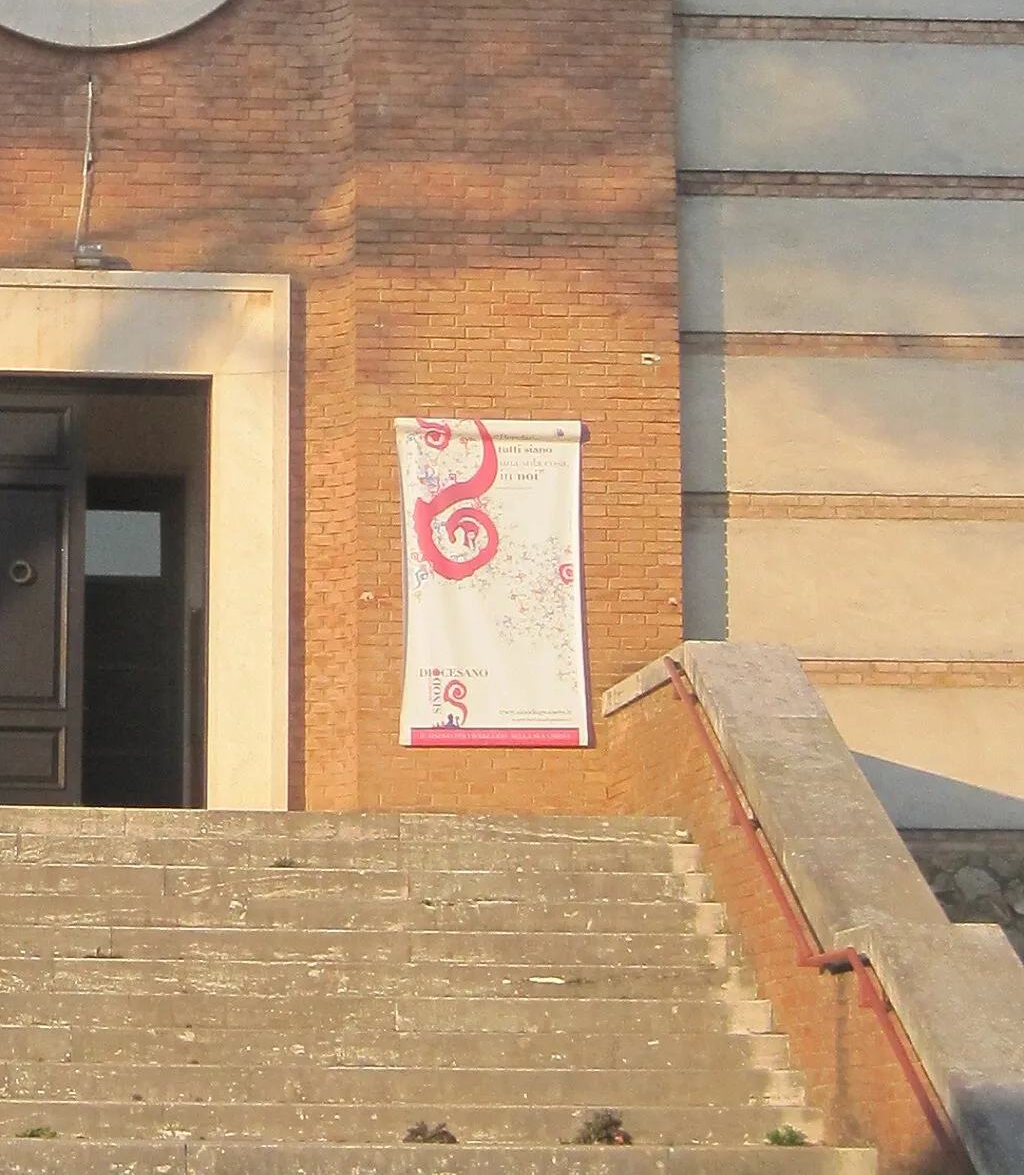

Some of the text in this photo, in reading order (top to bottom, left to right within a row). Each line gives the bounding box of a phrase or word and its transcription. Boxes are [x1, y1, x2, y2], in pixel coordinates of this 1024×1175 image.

[498, 444, 553, 454] tutti siano
[500, 469, 513, 481] in
[419, 668, 489, 678] DIOCESANO
